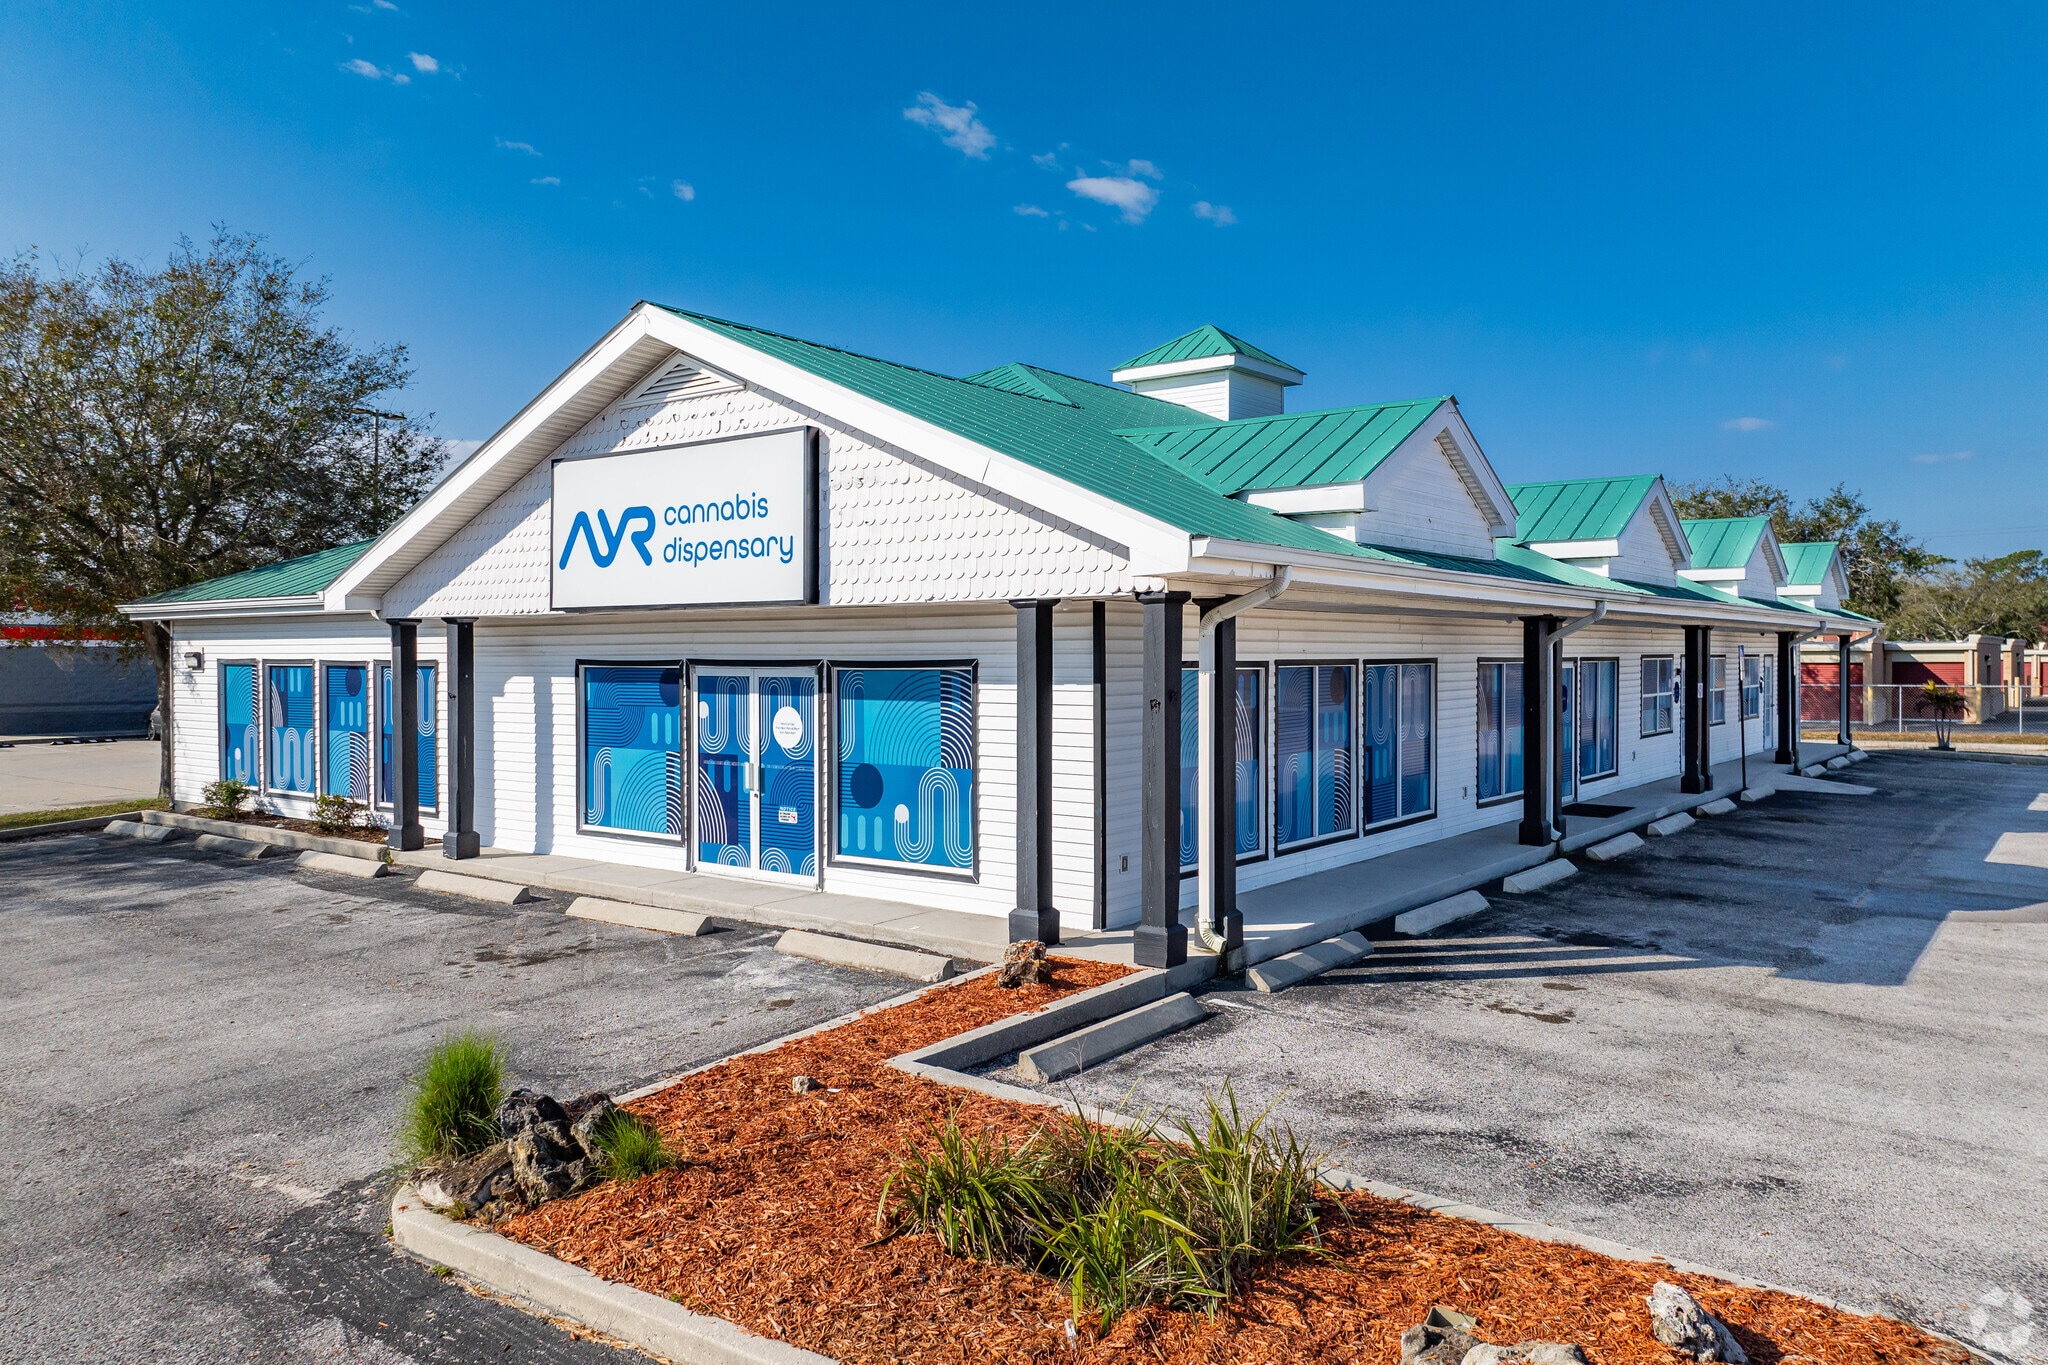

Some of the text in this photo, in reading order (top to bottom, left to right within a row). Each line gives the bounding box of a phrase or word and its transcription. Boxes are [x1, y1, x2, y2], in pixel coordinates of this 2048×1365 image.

[664, 492, 768, 525] cannabis
[559, 505, 656, 570] AYR
[663, 535, 794, 568] dispensary
